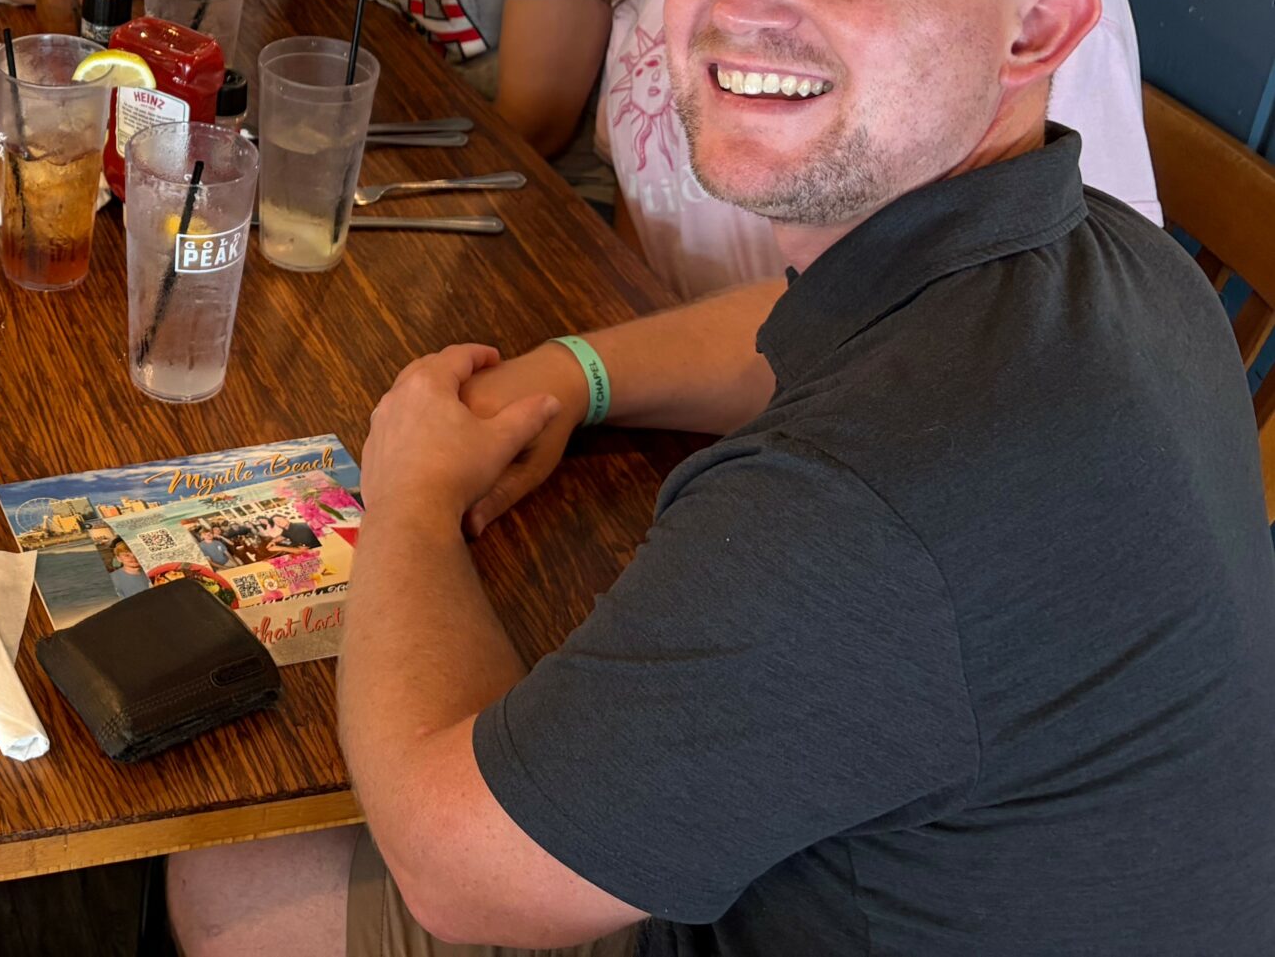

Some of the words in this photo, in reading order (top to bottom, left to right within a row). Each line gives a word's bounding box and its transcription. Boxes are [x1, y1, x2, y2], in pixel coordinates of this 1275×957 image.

[133, 91, 165, 110] HEINZ
[183, 241, 240, 268] PEAK
[184, 232, 241, 250] GOLD
[588, 360, 605, 403] CHAPEL
[144, 460, 254, 499] Myrtle
[254, 446, 335, 478] Beach
